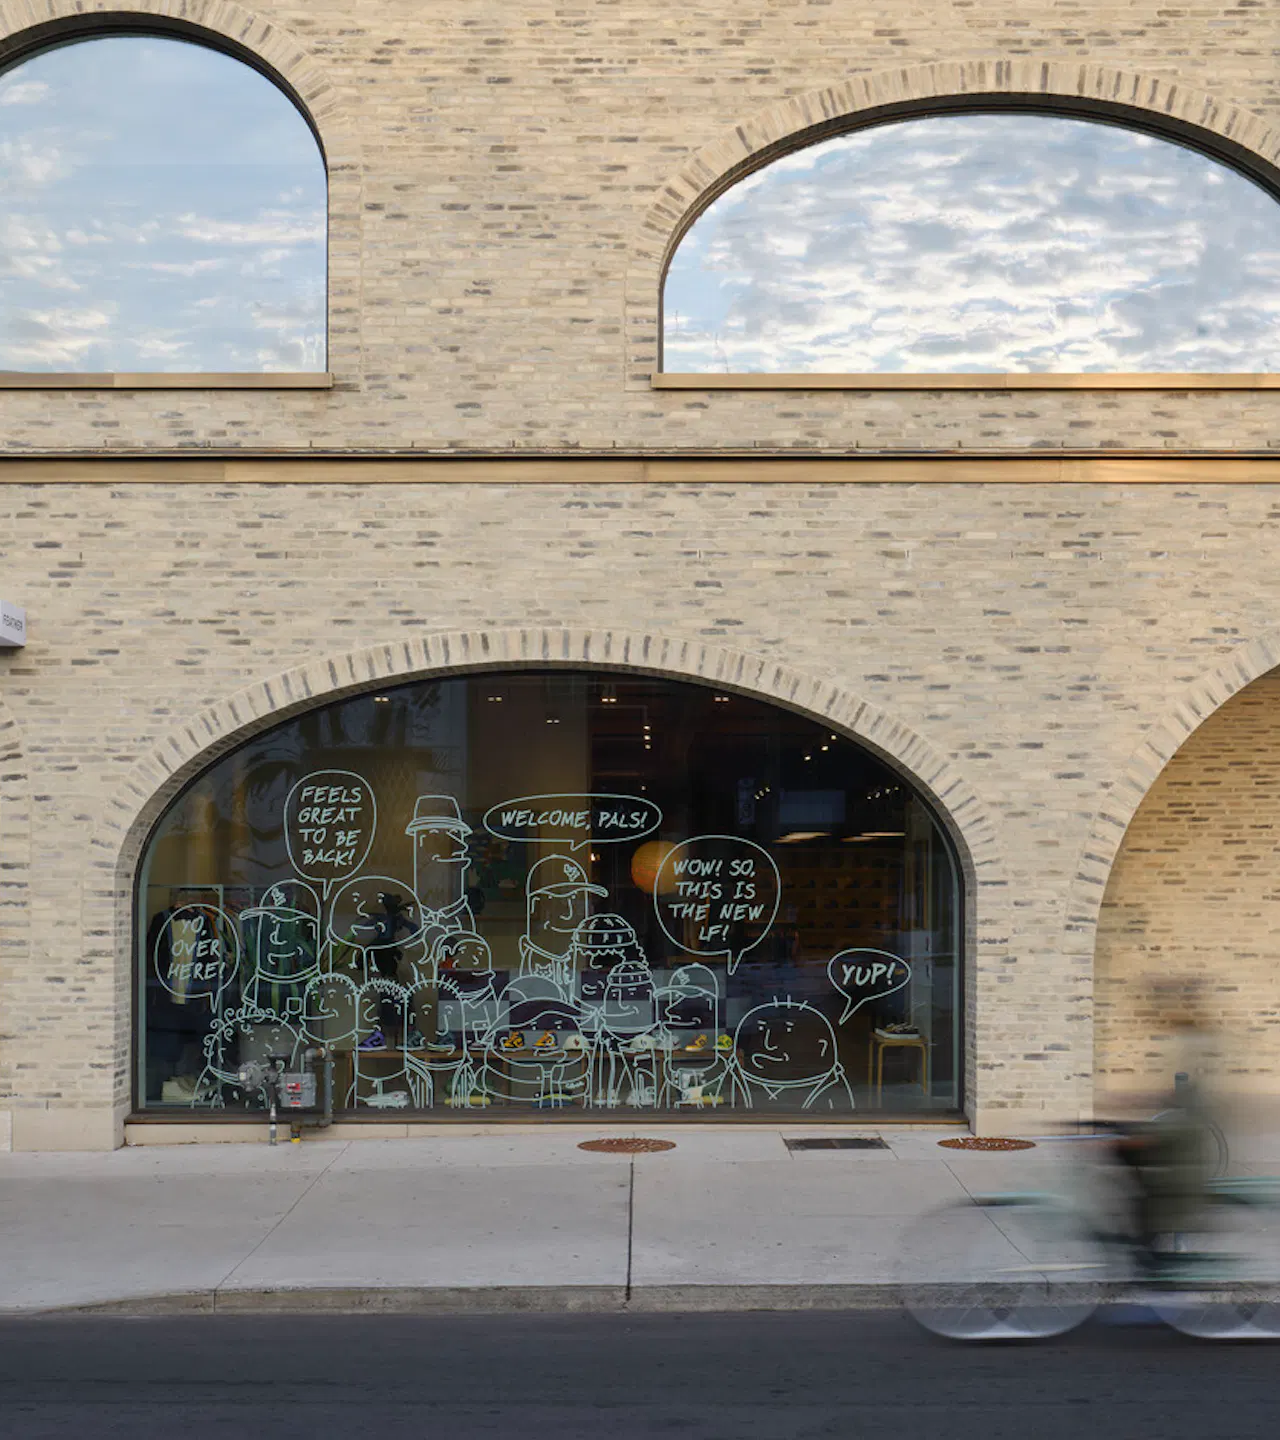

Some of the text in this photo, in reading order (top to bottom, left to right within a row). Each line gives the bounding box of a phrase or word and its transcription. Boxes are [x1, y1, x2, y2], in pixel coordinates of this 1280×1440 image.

[301, 786, 361, 803] FEELS
[298, 807, 362, 824] GREAT
[501, 809, 648, 831] WELCOME, PALS!
[299, 827, 361, 847] TO BE
[302, 848, 355, 868] BACK!
[673, 858, 723, 877] WOW!
[675, 881, 756, 900] THIS IS
[668, 903, 765, 922] THE NEW
[699, 924, 730, 942] LF!
[171, 939, 221, 957] OVER
[167, 961, 226, 980] HERE!
[842, 962, 896, 986] YUP!
